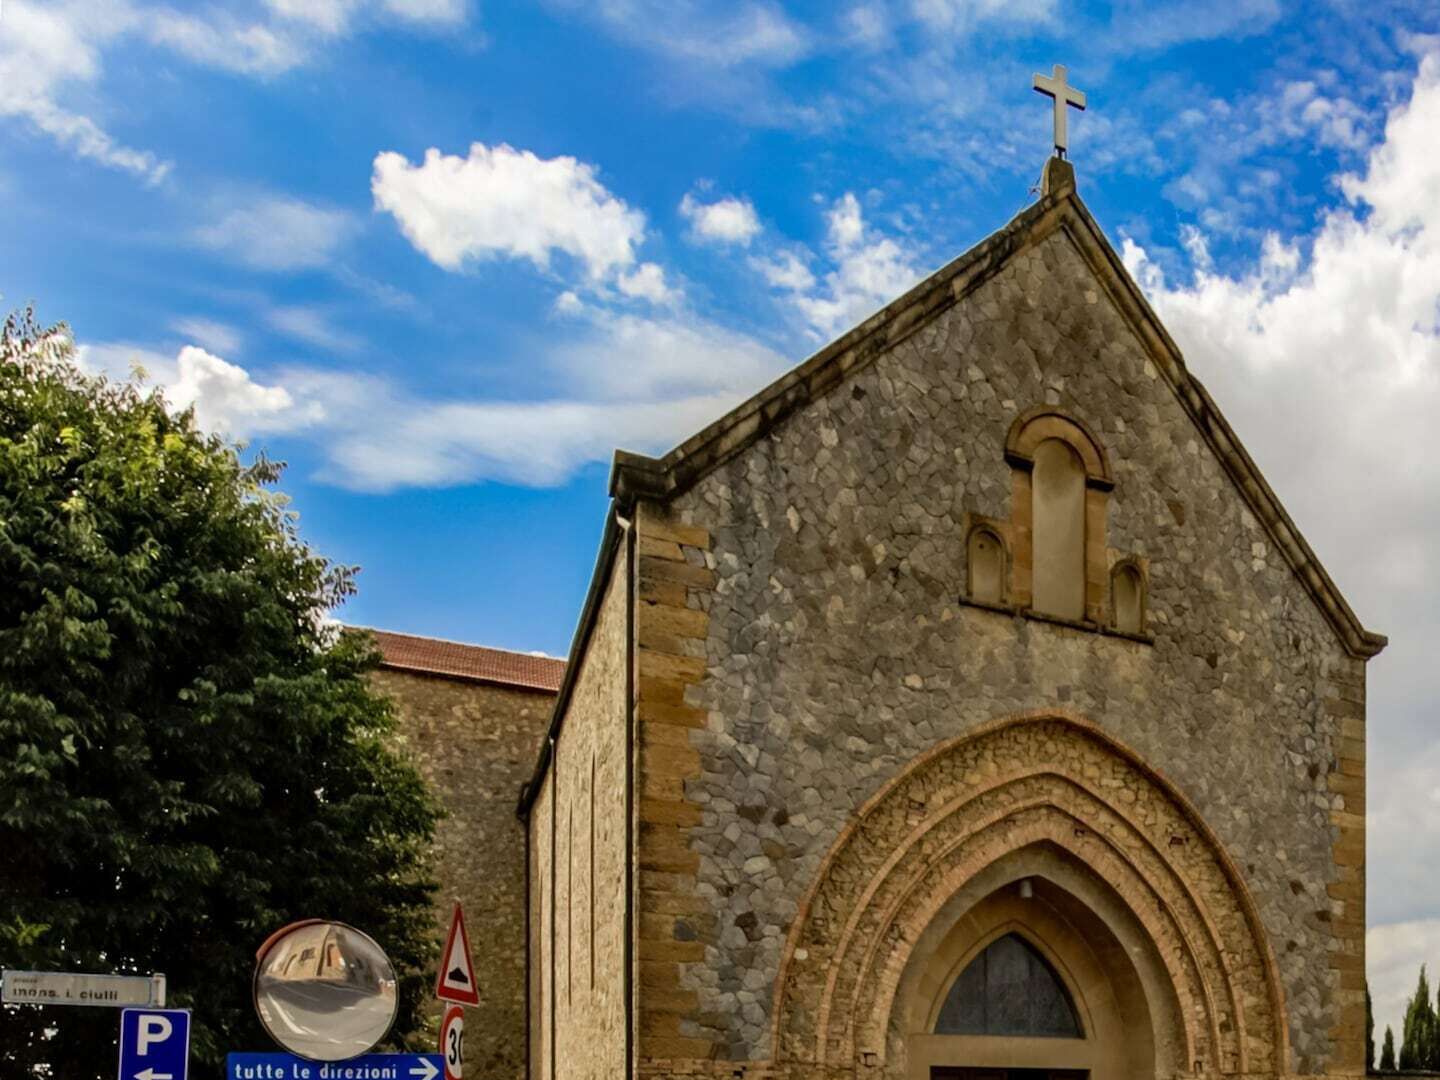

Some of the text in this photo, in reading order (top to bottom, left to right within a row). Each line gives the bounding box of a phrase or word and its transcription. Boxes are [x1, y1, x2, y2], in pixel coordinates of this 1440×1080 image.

[80, 989, 118, 1000] ciulli
[136, 1014, 173, 1056] P
[235, 1063, 397, 1079] tutte le direzioni
